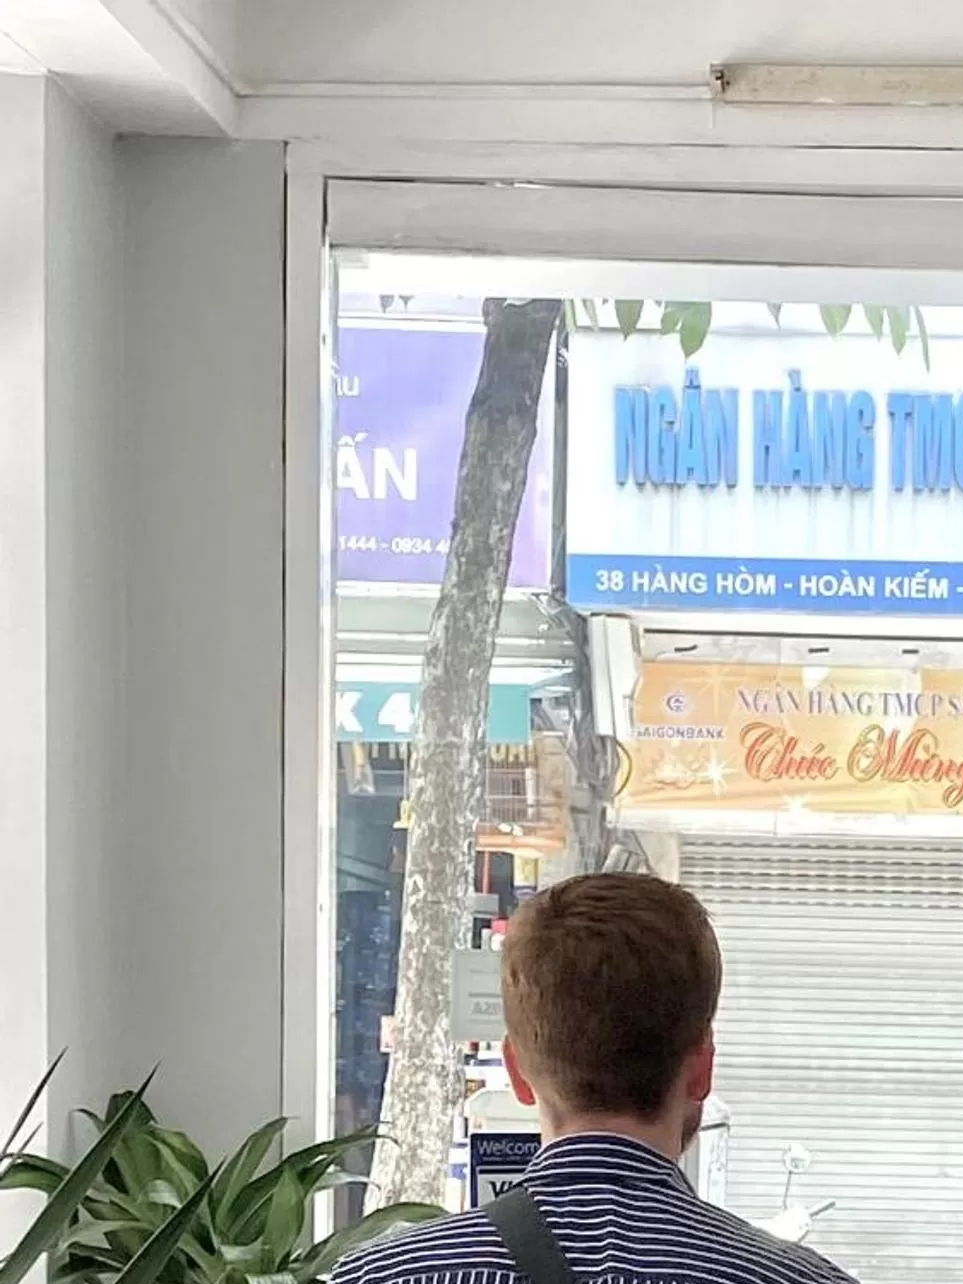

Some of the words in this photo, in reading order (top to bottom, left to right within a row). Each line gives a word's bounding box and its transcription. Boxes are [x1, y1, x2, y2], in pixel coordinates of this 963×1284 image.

[613, 366, 739, 489] NGÂN
[753, 368, 876, 492] HÀNG
[595, 570, 624, 593] 38
[632, 564, 708, 594] HÀNG
[716, 566, 777, 596] HÒM
[800, 569, 875, 598] HOÀN
[884, 568, 949, 601] KIẾM
[378, 692, 418, 733] 4
[739, 721, 841, 783] Chúc
